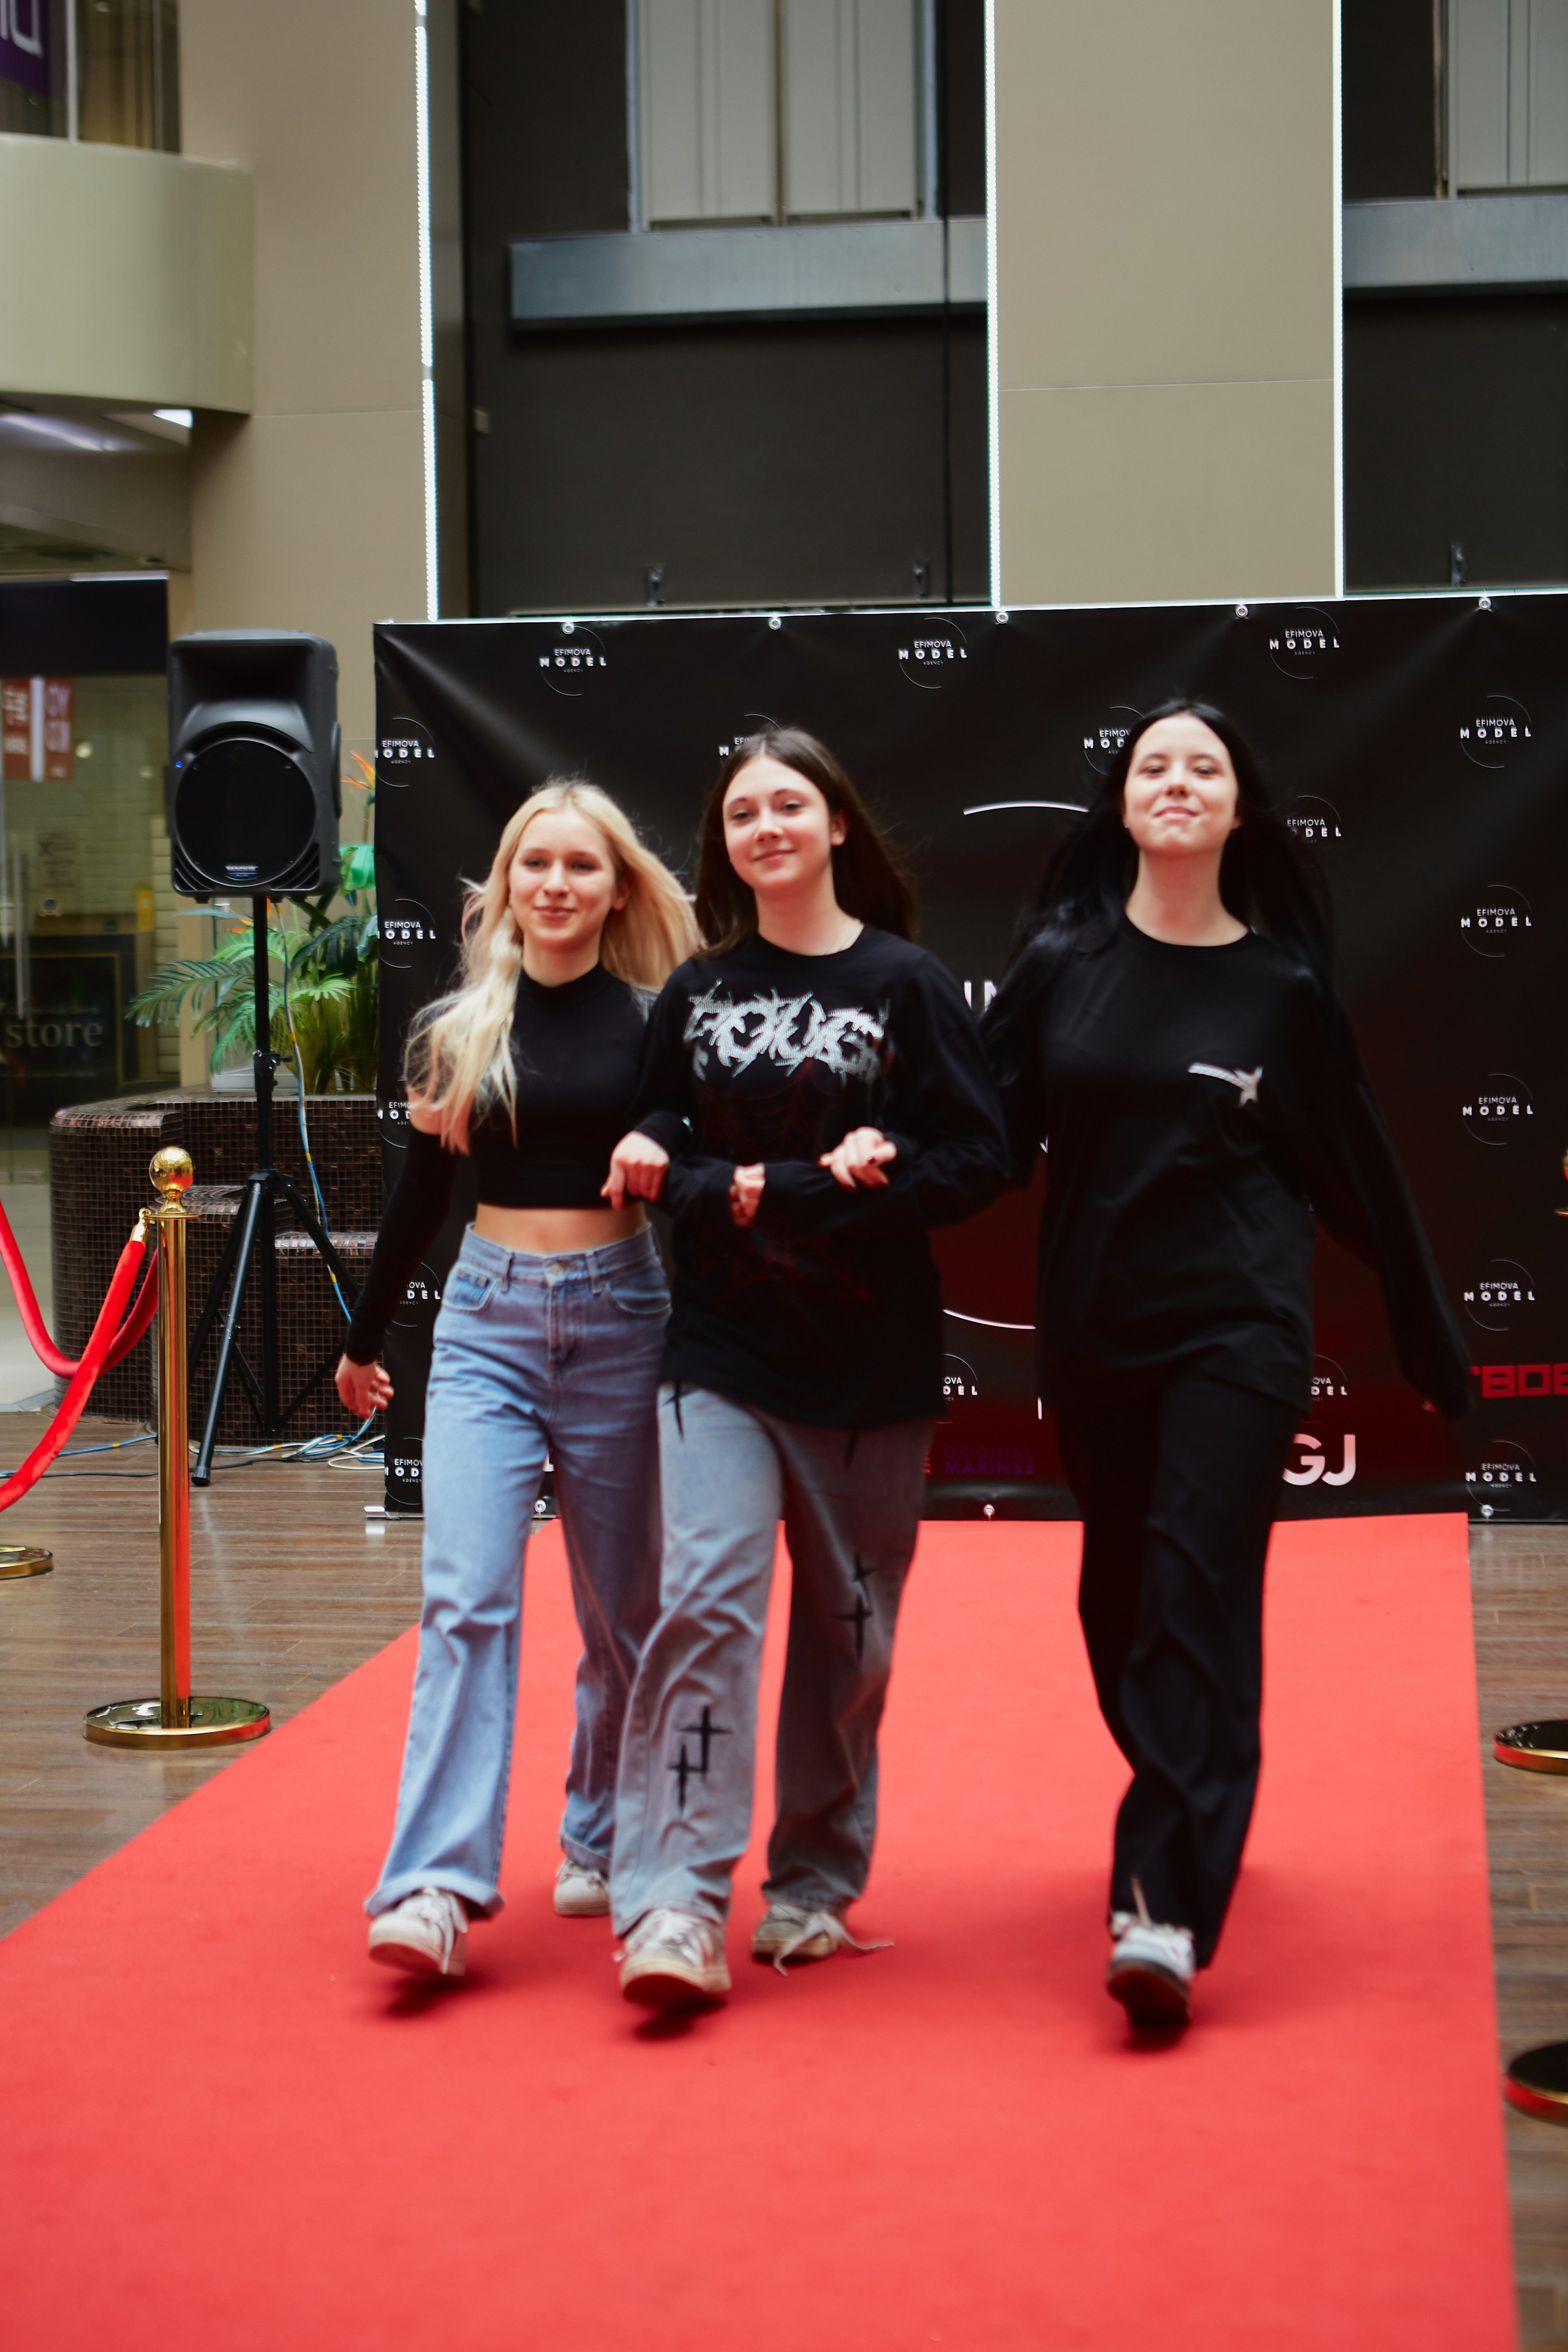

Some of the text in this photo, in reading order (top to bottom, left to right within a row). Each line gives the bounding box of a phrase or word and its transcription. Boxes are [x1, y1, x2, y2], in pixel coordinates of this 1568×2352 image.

[1269, 638, 1340, 649] MODEL
[898, 649, 967, 660] MODEL
[540, 657, 606, 667] MODEL
[1476, 718, 1515, 727] EFIMOVA
[1099, 729, 1131, 737] EFIMOV
[1460, 726, 1531, 739] MODEL
[1084, 738, 1125, 749] MOD
[1477, 908, 1515, 916] EFIMOVA
[1461, 916, 1532, 928] MODEL
[1463, 1104, 1534, 1116] MODEL
[407, 1290, 441, 1300] DEL
[1463, 1291, 1536, 1302] MODEL
[943, 1385, 978, 1395] DEL
[1311, 1385, 1348, 1395] DEL
[943, 1446, 1034, 1459] ORIGINAL
[1281, 1433, 1356, 1486] GJ
[944, 1460, 1035, 1474] MARINES
[1465, 1472, 1537, 1482] MODEL
